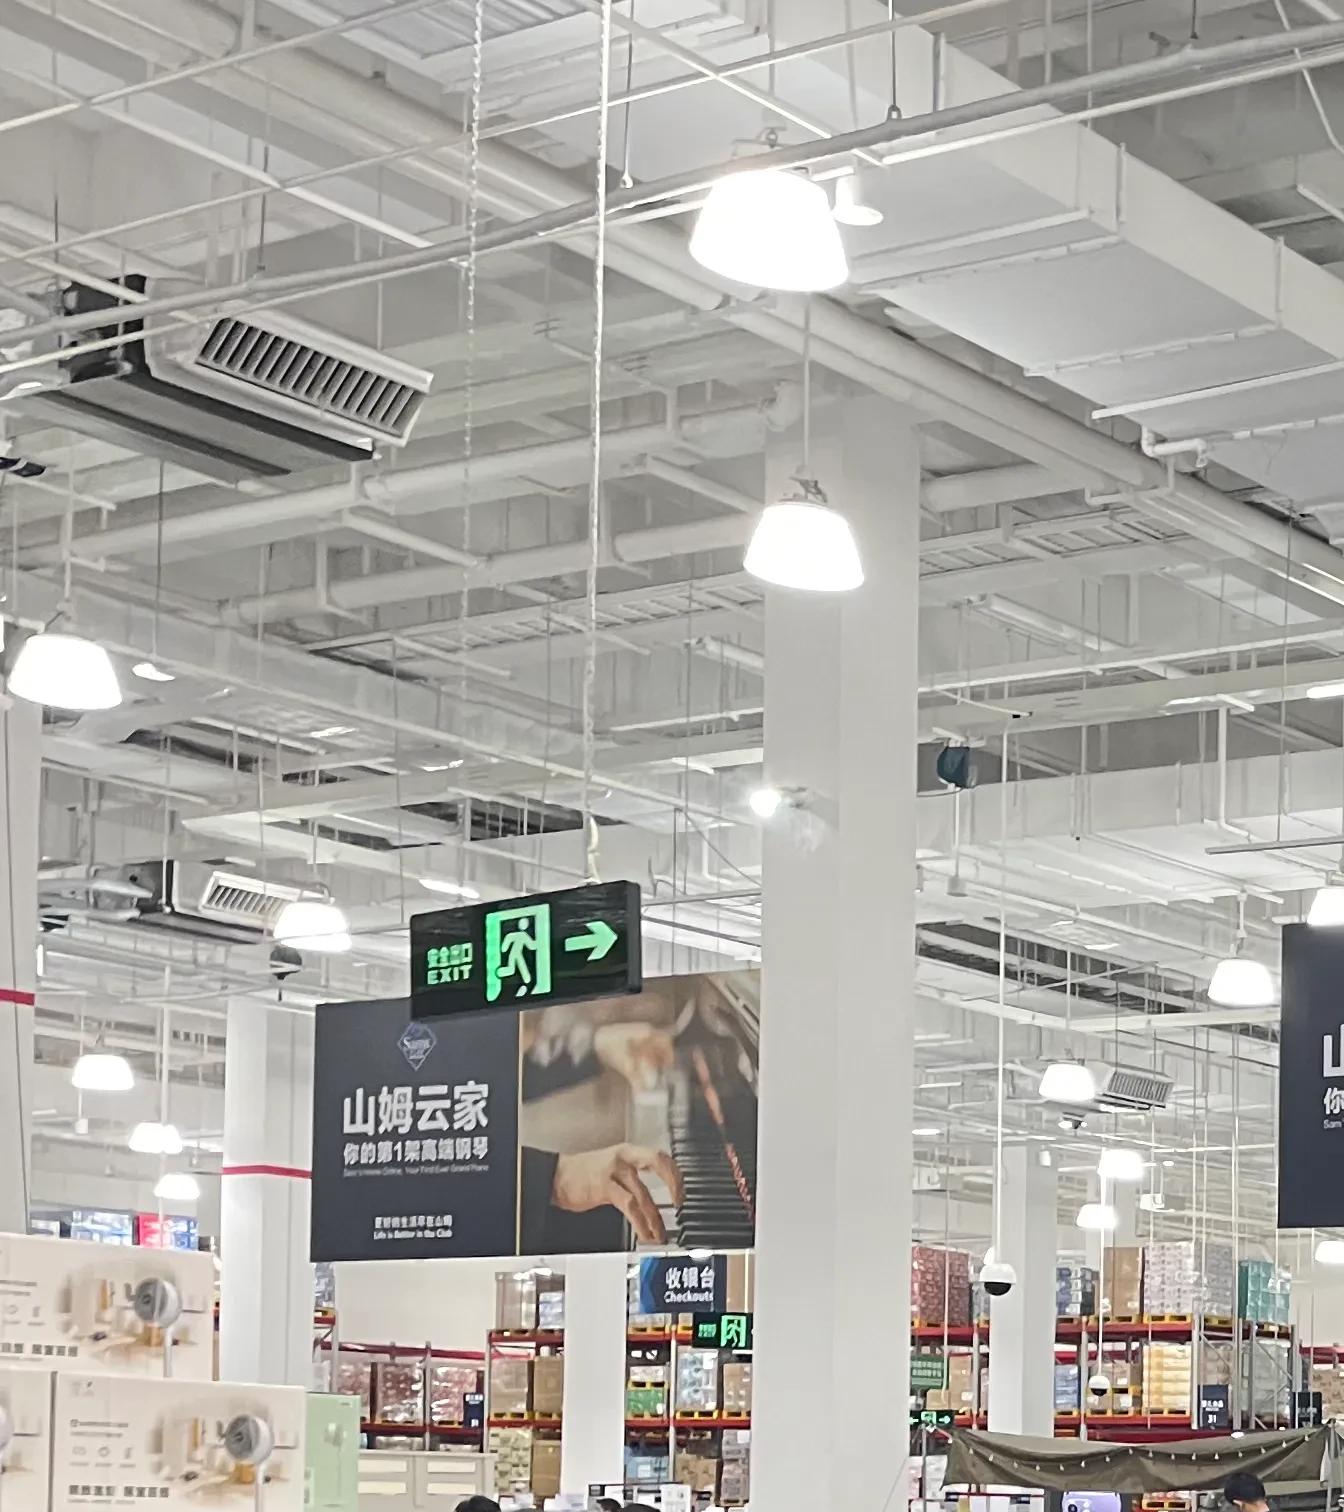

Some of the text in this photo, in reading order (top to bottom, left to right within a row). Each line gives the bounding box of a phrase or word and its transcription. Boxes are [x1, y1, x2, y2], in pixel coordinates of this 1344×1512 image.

[427, 964, 472, 985] EXIT
[343, 1080, 489, 1136] 山姆云家
[665, 1265, 715, 1289] 收银台
[663, 1290, 714, 1303] Checkouts
